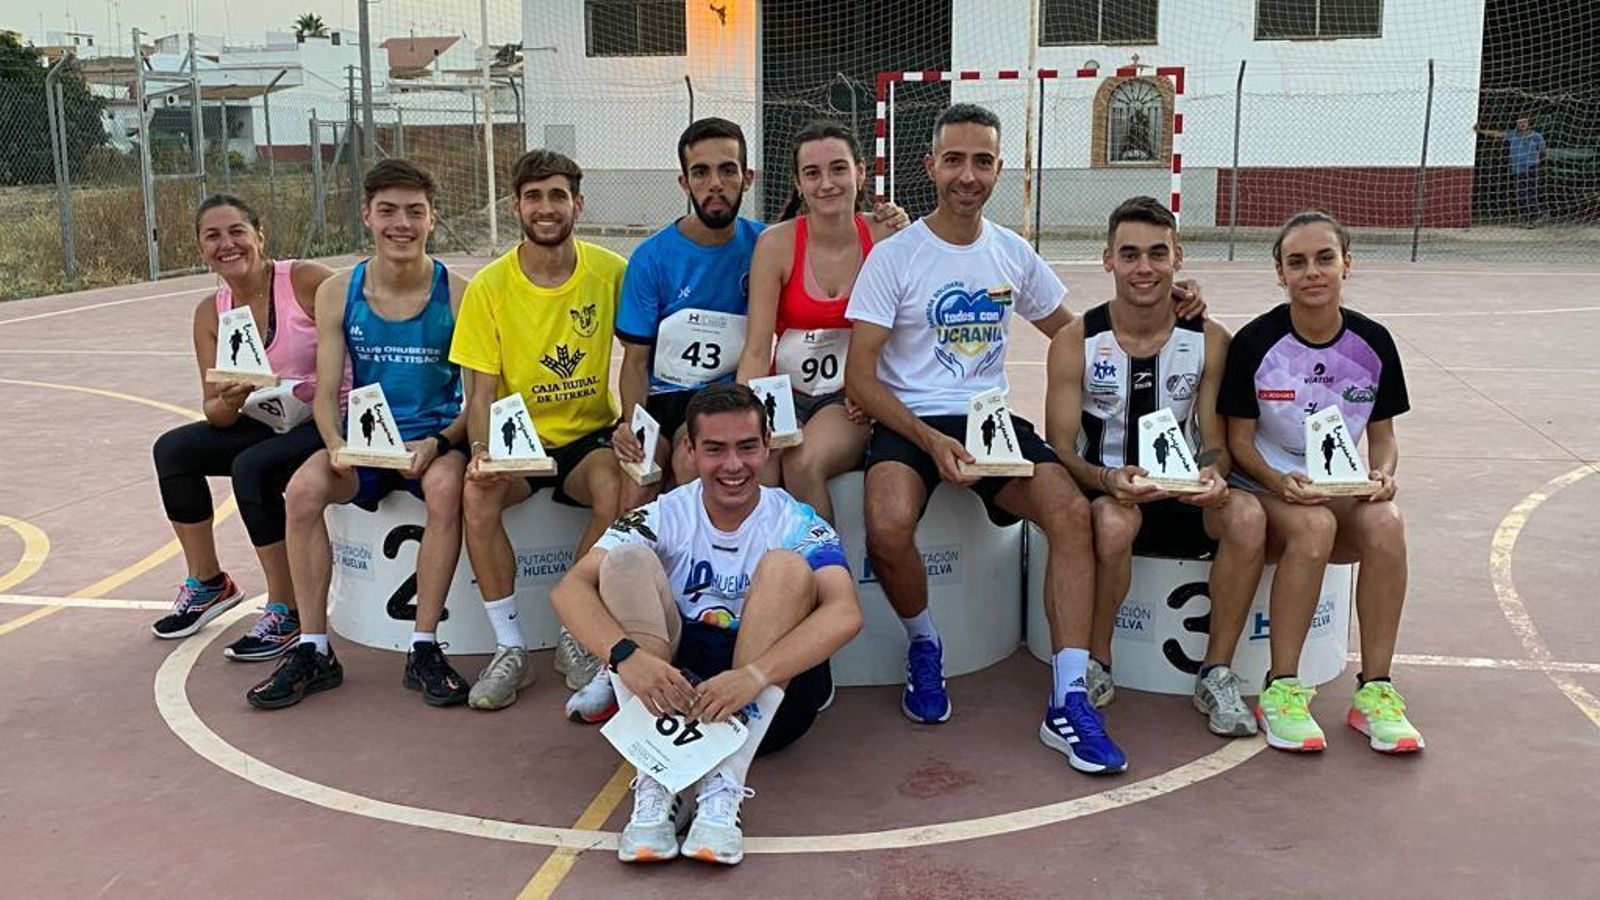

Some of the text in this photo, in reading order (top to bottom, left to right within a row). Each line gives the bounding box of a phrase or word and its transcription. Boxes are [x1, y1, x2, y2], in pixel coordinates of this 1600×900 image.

[944, 310, 999, 323] todos con
[937, 326, 1003, 344] UCRANIA
[681, 341, 722, 370] 43
[801, 353, 838, 383] 90
[531, 375, 601, 394] CAJA RURAL
[536, 395, 552, 404] DE
[517, 550, 573, 566] PUTACIÓN
[923, 549, 959, 564] TACIÓN
[383, 524, 449, 621] 2
[523, 562, 567, 577] HUELVA
[927, 564, 953, 576] ELVA
[1115, 616, 1143, 630] ELVA
[1162, 581, 1212, 675] 3
[1312, 614, 1331, 628] ELVA
